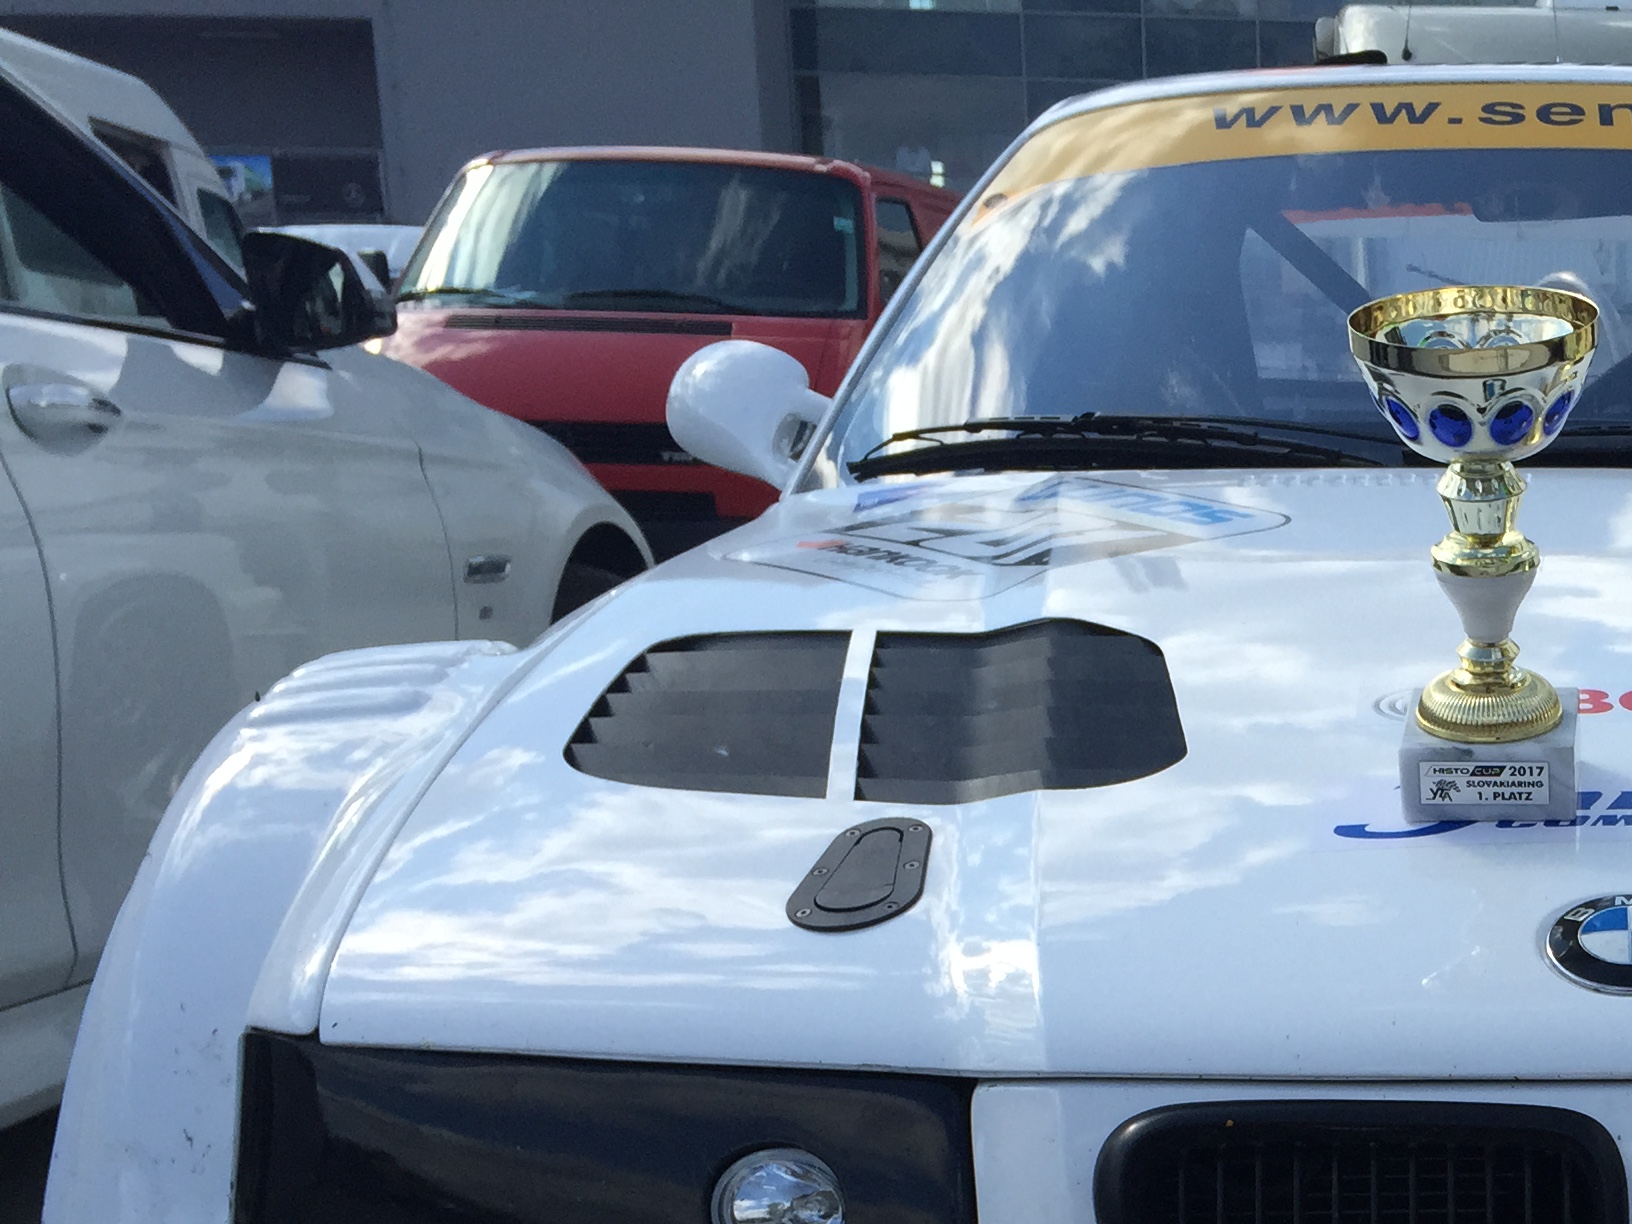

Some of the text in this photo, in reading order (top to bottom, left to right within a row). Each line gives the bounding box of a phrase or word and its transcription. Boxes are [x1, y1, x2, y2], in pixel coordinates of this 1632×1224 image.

[1473, 767, 1501, 775] CUP
[1508, 765, 1545, 777] 2017
[1465, 779, 1545, 789] SLOVAKIARING
[1477, 791, 1533, 801] 1. PLATZ
